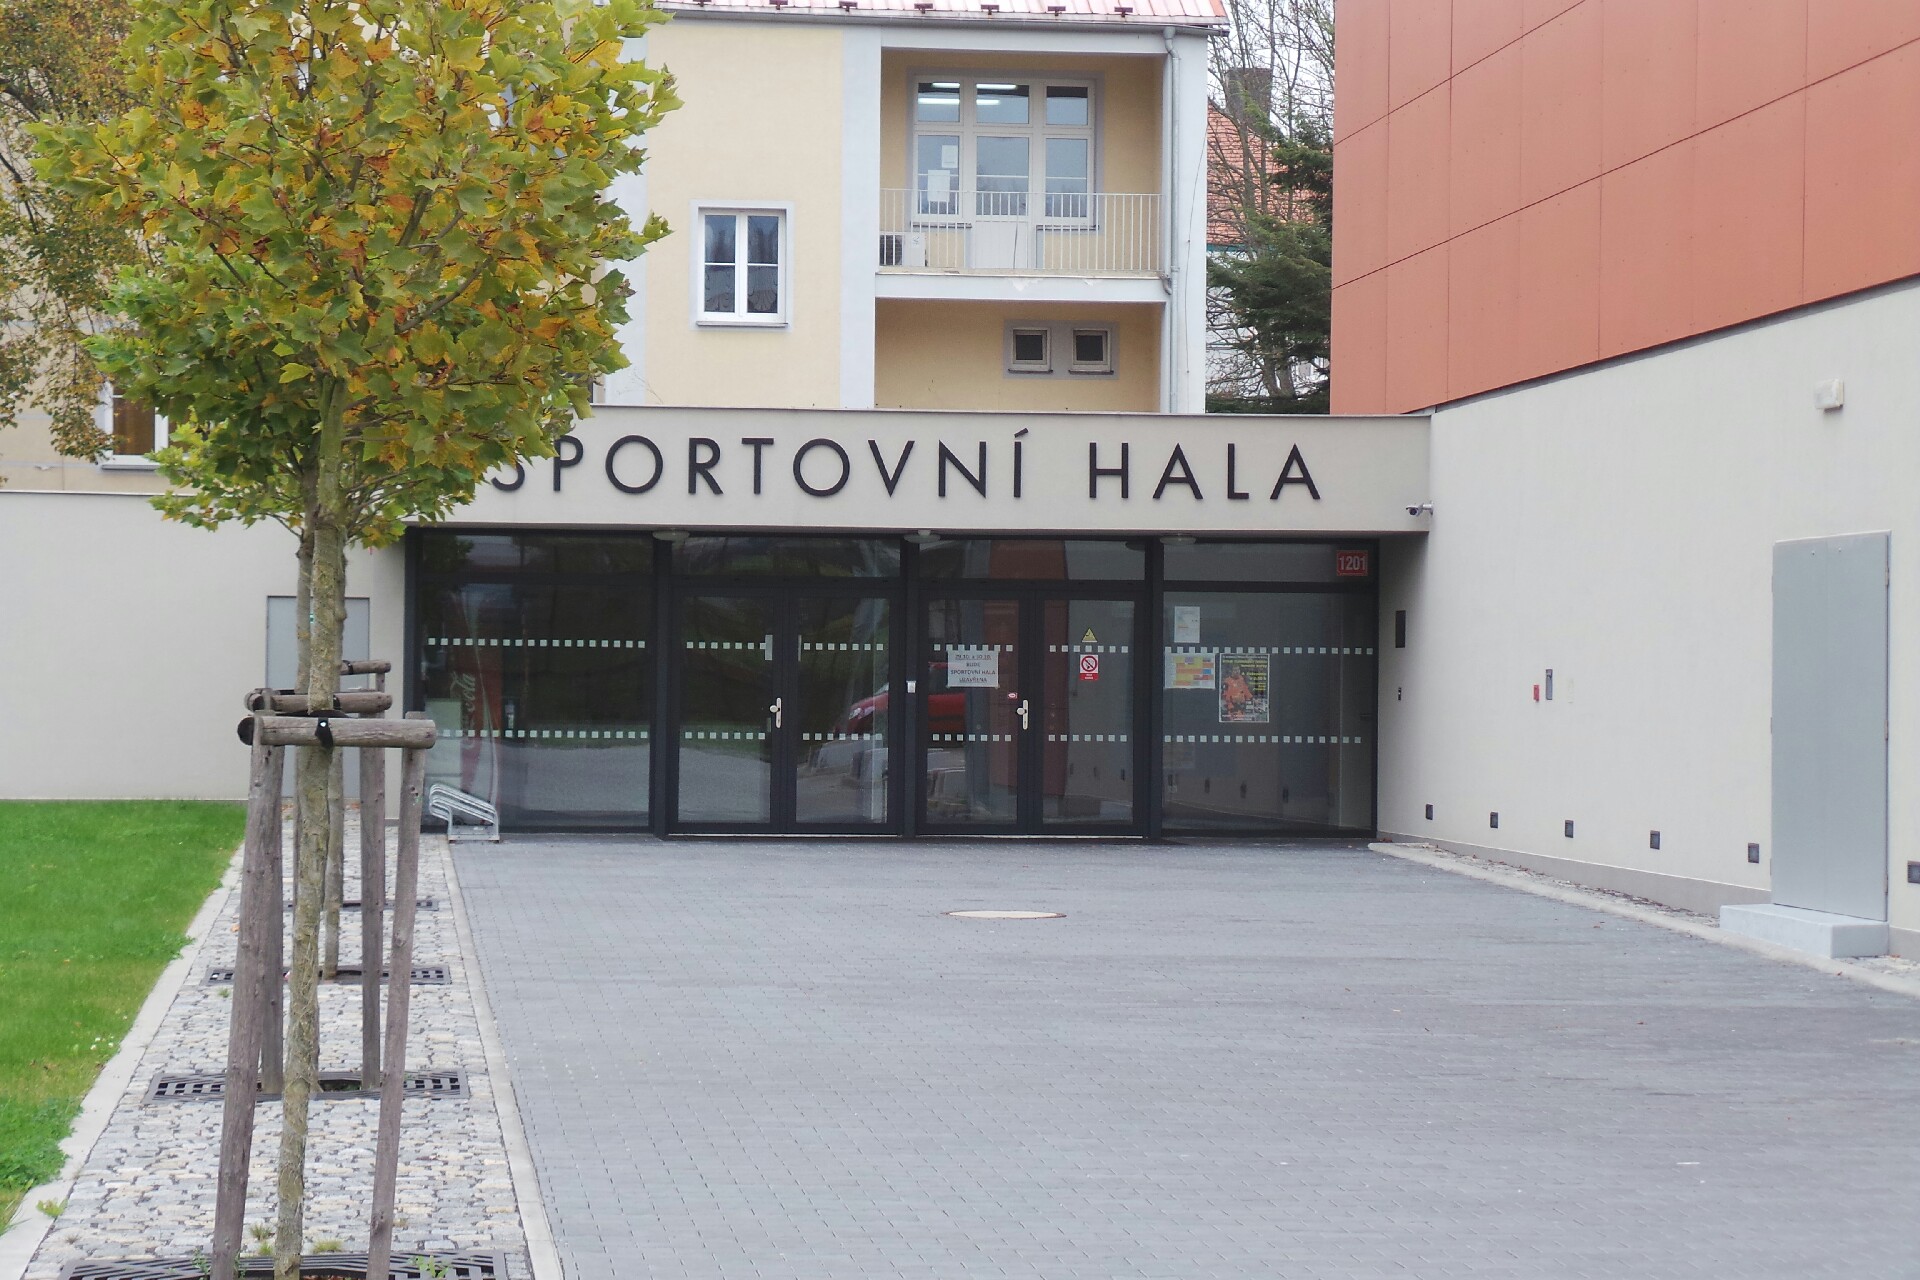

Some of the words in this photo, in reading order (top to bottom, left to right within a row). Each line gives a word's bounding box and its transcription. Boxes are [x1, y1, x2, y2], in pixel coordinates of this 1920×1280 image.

[491, 428, 1029, 498] SPORTOVNÍ
[1089, 442, 1321, 500] HALA
[1339, 555, 1366, 571] 1201
